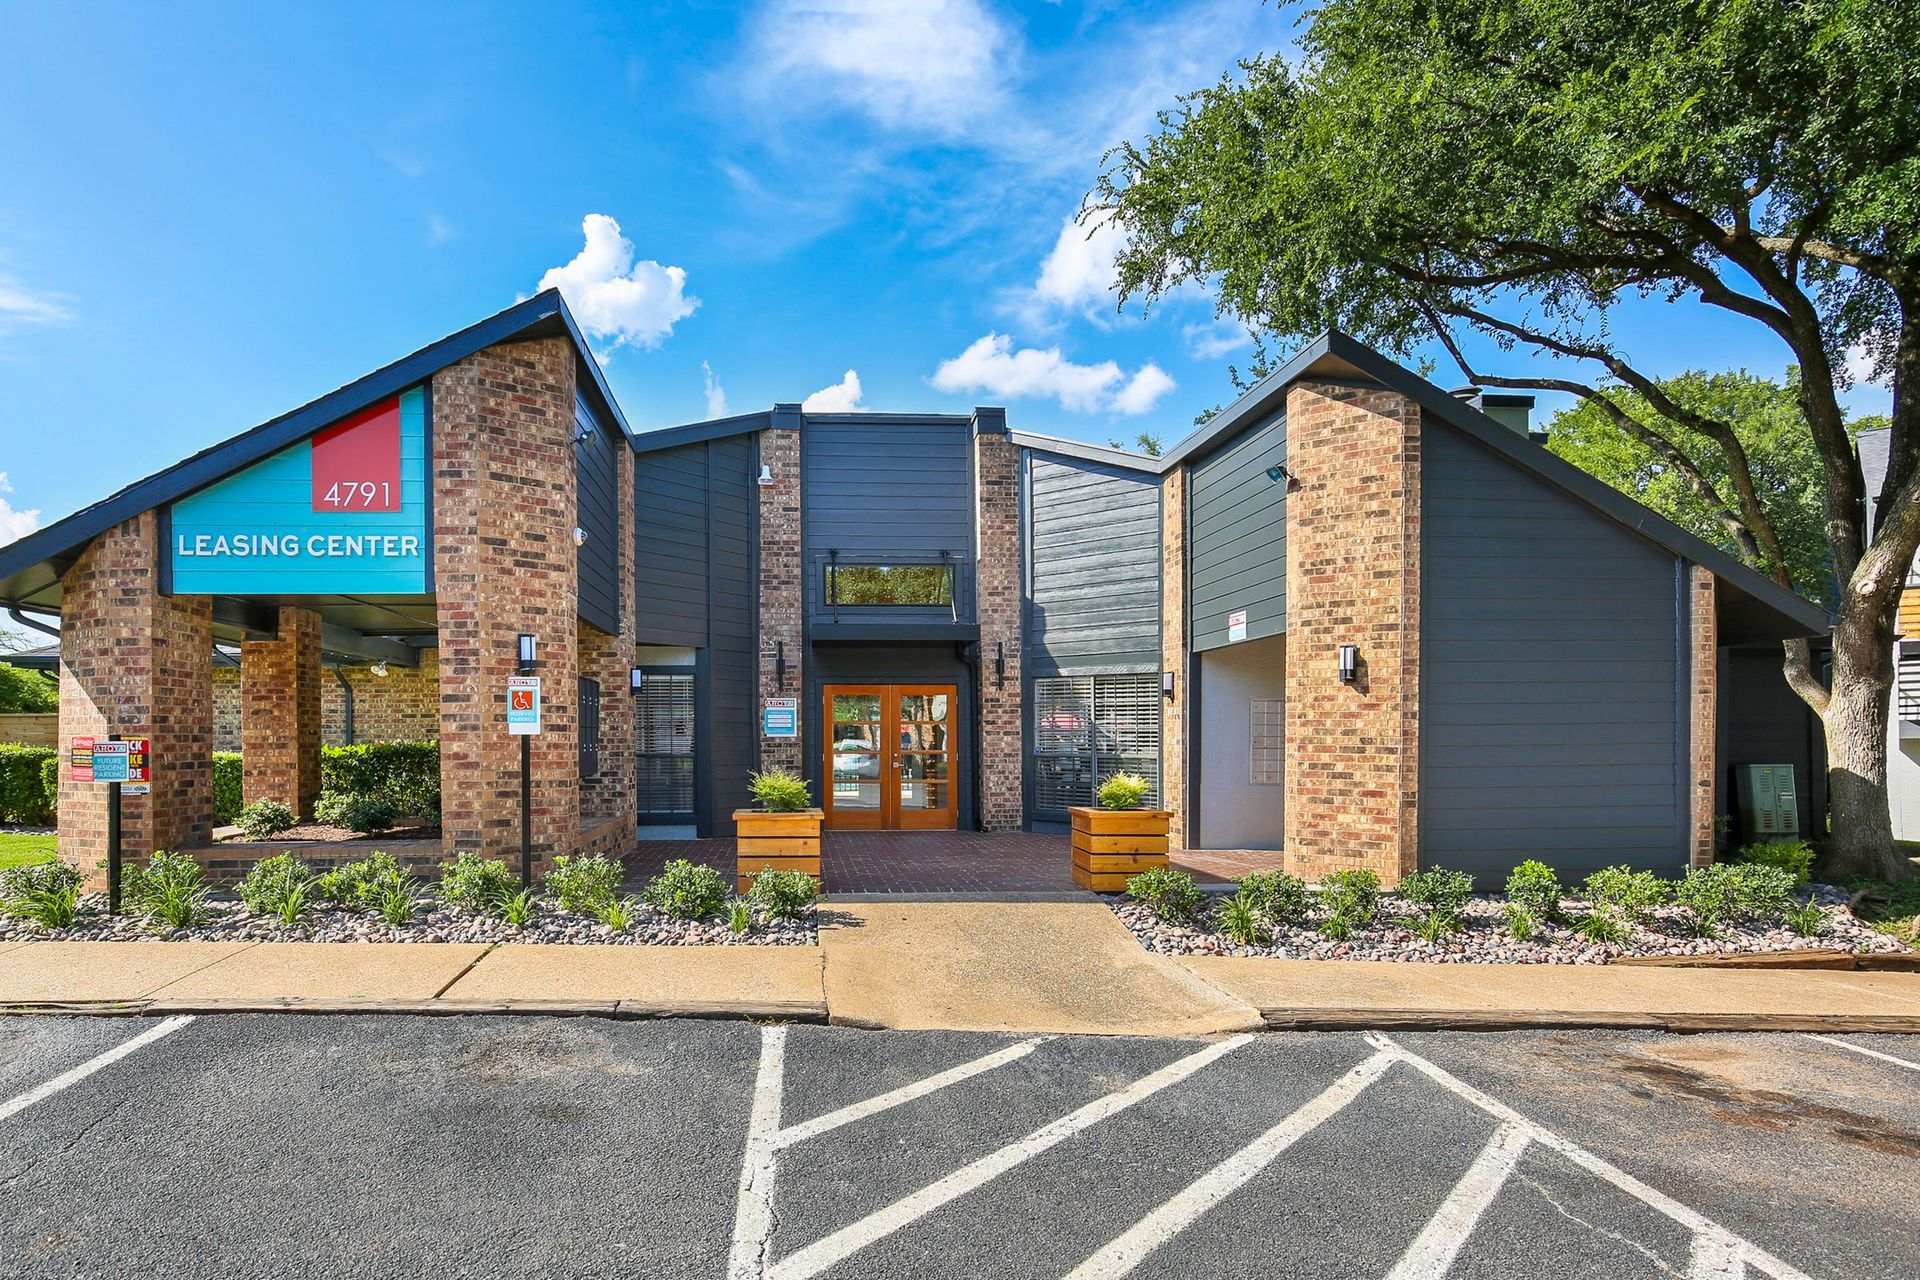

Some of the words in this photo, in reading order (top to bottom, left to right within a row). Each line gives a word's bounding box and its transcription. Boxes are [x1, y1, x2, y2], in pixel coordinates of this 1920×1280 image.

[323, 481, 391, 507] 4791
[178, 534, 299, 557] LEASING
[306, 535, 419, 557] CENTER
[129, 740, 143, 751] CK
[129, 754, 143, 765] KE
[129, 768, 142, 779] DE
